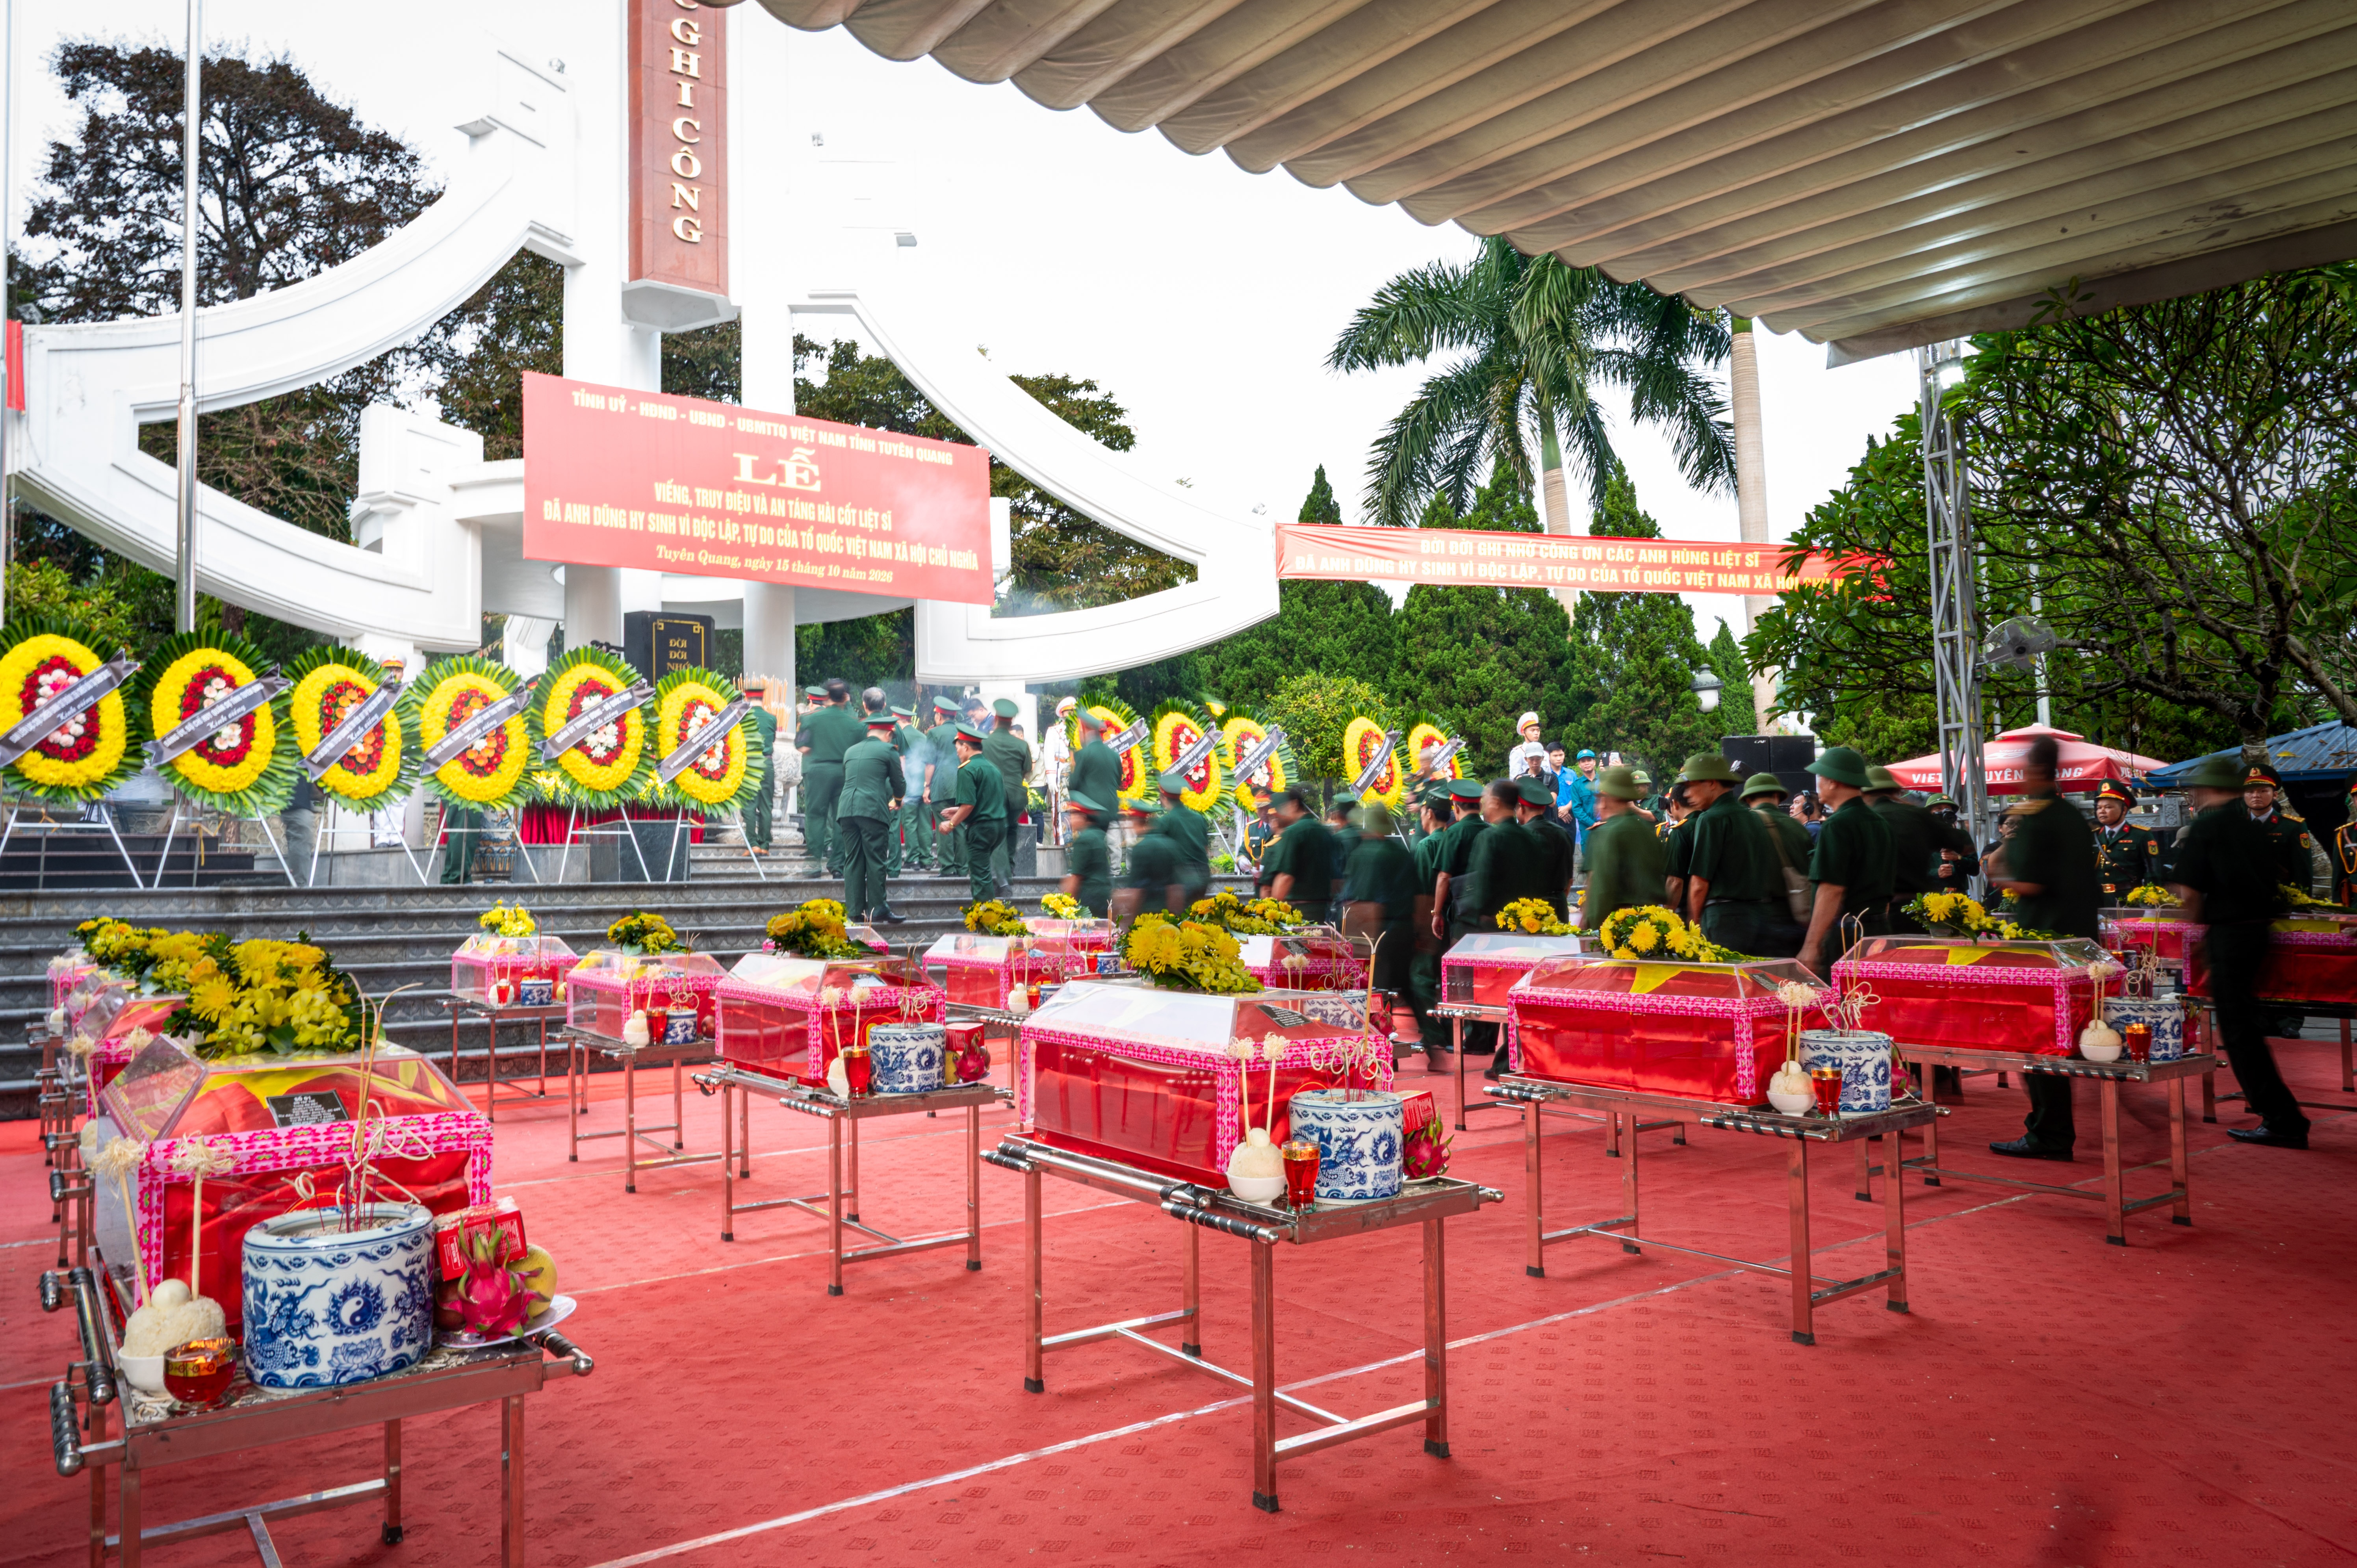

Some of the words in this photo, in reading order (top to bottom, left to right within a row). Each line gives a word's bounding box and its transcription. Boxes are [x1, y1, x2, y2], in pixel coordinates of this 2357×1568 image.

[669, 18, 702, 108] GHI
[671, 117, 704, 244] CÔNG
[572, 389, 605, 410] TỈNH
[640, 402, 677, 421] HĐND
[689, 410, 725, 428] UBND
[737, 418, 787, 438] UBMTTQ
[790, 425, 815, 444] VIỆT
[818, 431, 846, 448] NAM
[849, 433, 876, 453] TỈNH
[878, 440, 913, 459] TUYÊN
[916, 447, 953, 465] QUANG
[733, 447, 821, 492] LỄ
[655, 479, 692, 507] VIẾNG,
[695, 488, 723, 510] TRUY
[726, 489, 751, 516] ĐIỆU
[753, 494, 768, 515] VÀ
[770, 497, 785, 517] AN
[788, 497, 815, 521] TÁNG
[818, 501, 835, 523] HÀI
[837, 502, 856, 527] CỐT
[859, 508, 879, 532] LIỆT
[881, 510, 892, 531] SĨ
[543, 497, 561, 521] ĐÃ
[564, 503, 590, 525] ANH
[593, 504, 626, 529] DŨNG
[630, 510, 645, 531] HY
[648, 512, 676, 536] SINH
[679, 513, 690, 536] VÌ
[693, 516, 716, 542] ĐỘC
[718, 518, 741, 544] LẬP,
[743, 523, 758, 547] TỰ
[760, 526, 774, 545] DO
[776, 523, 798, 548] CỦA
[800, 525, 814, 550] TỔ
[816, 529, 844, 554] QUỐC
[846, 534, 867, 559] VIỆT
[869, 540, 893, 560] NAM
[895, 541, 908, 562] XÃ
[910, 543, 926, 567] HỘI
[928, 544, 947, 566] CHỦ
[950, 550, 979, 571] NGHĨA
[1421, 537, 1445, 554] ĐỜI
[1449, 538, 1473, 555] ĐỜI
[1477, 542, 1501, 557] GHI
[1505, 541, 1537, 558] NHỚ
[1539, 543, 1578, 559] CÔNG
[1582, 546, 1602, 561] ƠN
[1606, 546, 1634, 562] CÁC
[1638, 549, 1667, 564] ANH
[1671, 548, 1709, 565] HÙNG
[1713, 550, 1741, 569] LIỆT
[1745, 551, 1759, 568] SĨ
[656, 545, 694, 562] Tuyên
[698, 549, 741, 569] Quang,
[744, 556, 773, 572] ngày
[776, 558, 789, 572] 15
[792, 560, 826, 577] tháng
[827, 564, 840, 577] 10
[842, 567, 866, 580] năm
[868, 569, 893, 583] 2026
[1295, 554, 1316, 572] ĐÃ
[1320, 557, 1350, 572] ANH
[1355, 556, 1394, 573] DŨNG
[1399, 560, 1417, 575] HY
[1422, 561, 1456, 576] SINH
[1460, 560, 1474, 577] VÌ
[1478, 562, 1507, 581] ĐỘC
[1511, 562, 1542, 582] LẬP,
[1546, 566, 1565, 583] TỰ
[1567, 567, 1586, 582] DO
[1591, 564, 1619, 583] CỦA
[1622, 565, 1641, 584] TỔ
[1644, 567, 1681, 586] QUỐC
[1684, 570, 1714, 589] VIỆT
[1718, 574, 1750, 588] NAM
[1754, 573, 1773, 589] XÃ
[669, 637, 687, 648] ĐỜI
[669, 649, 687, 660] ĐỜI
[1985, 768, 2023, 781] UYÊN
